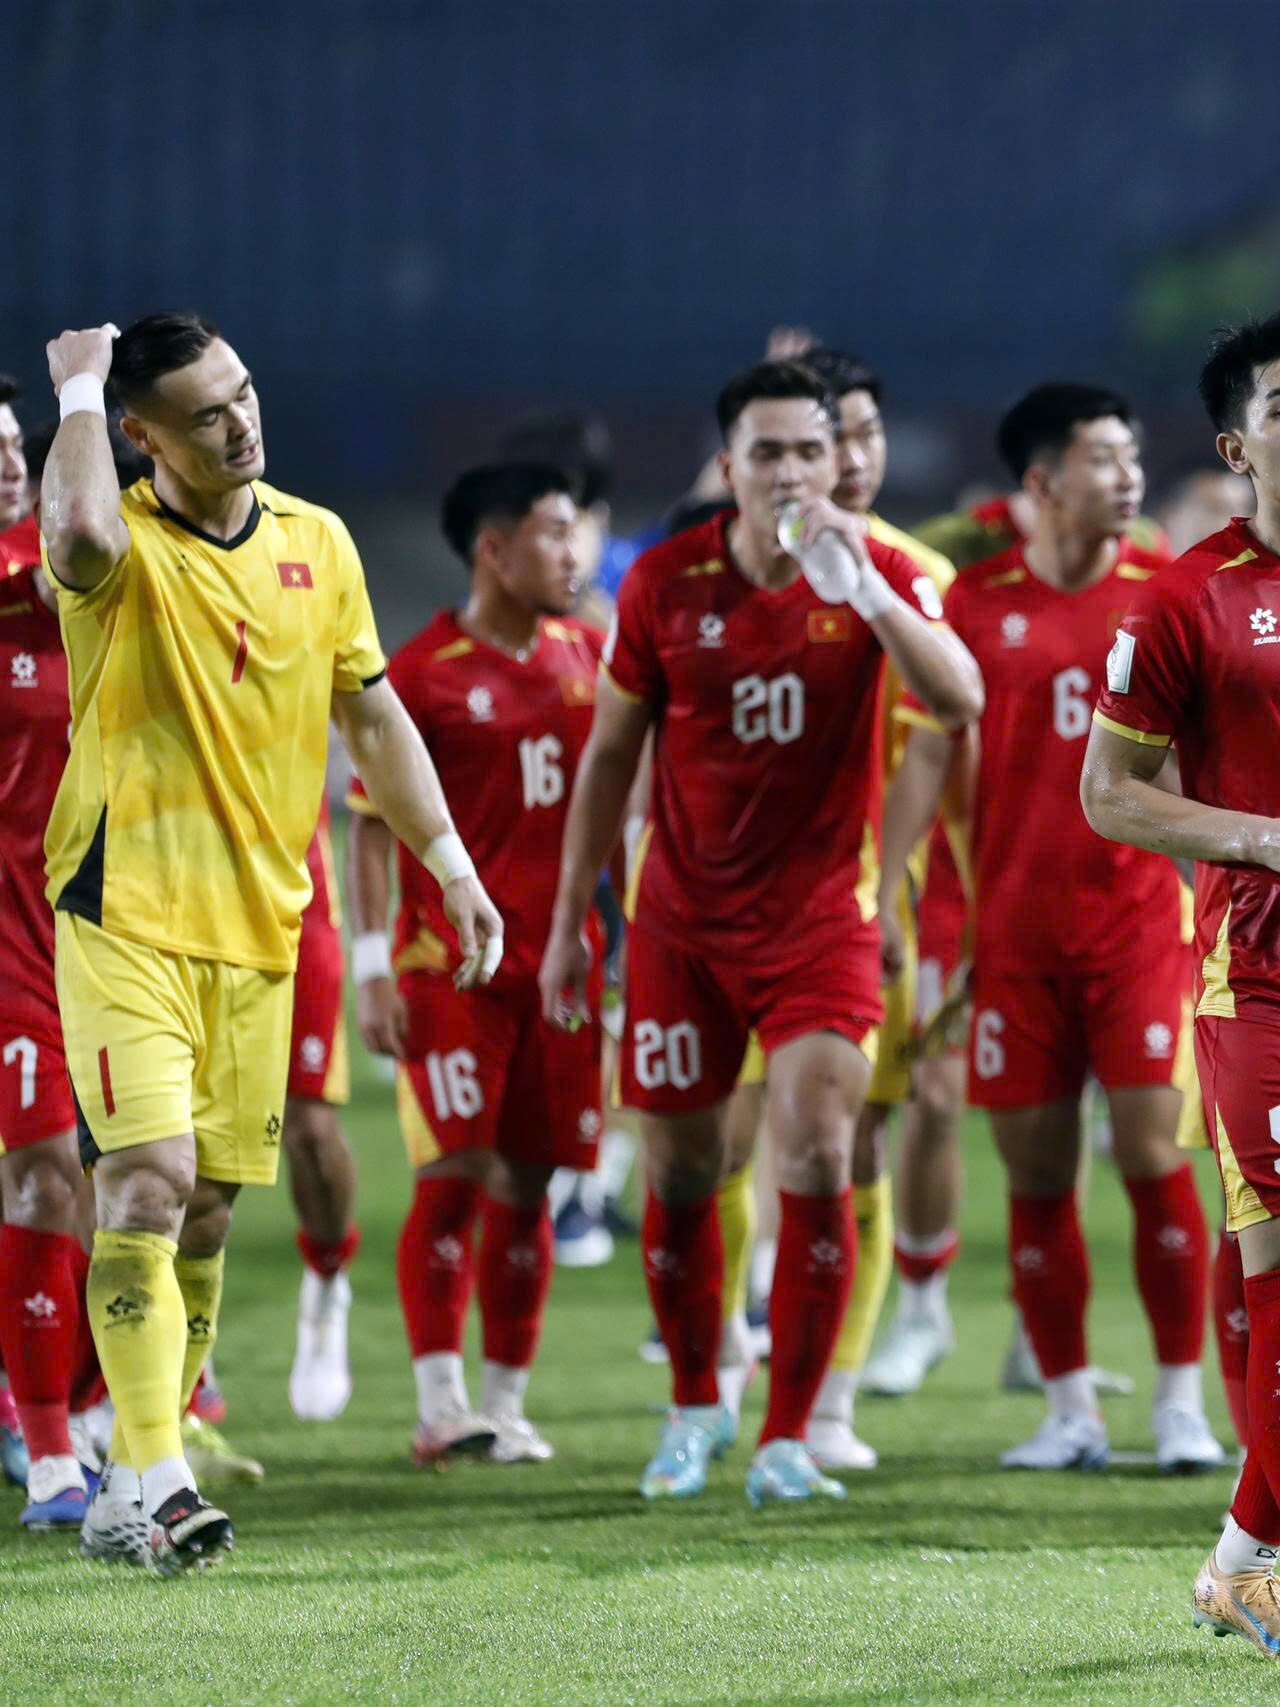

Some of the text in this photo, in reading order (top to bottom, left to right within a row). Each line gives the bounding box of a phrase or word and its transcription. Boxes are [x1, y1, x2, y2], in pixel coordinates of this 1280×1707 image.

[231, 620, 248, 684] 1
[732, 672, 804, 744] 20
[1053, 667, 1090, 740] 6
[519, 733, 563, 808] 16
[3, 1035, 38, 1109] 7
[634, 1018, 700, 1090] 20
[975, 1008, 1005, 1079] 6
[98, 1046, 116, 1118] 1
[425, 1047, 483, 1121] 16
